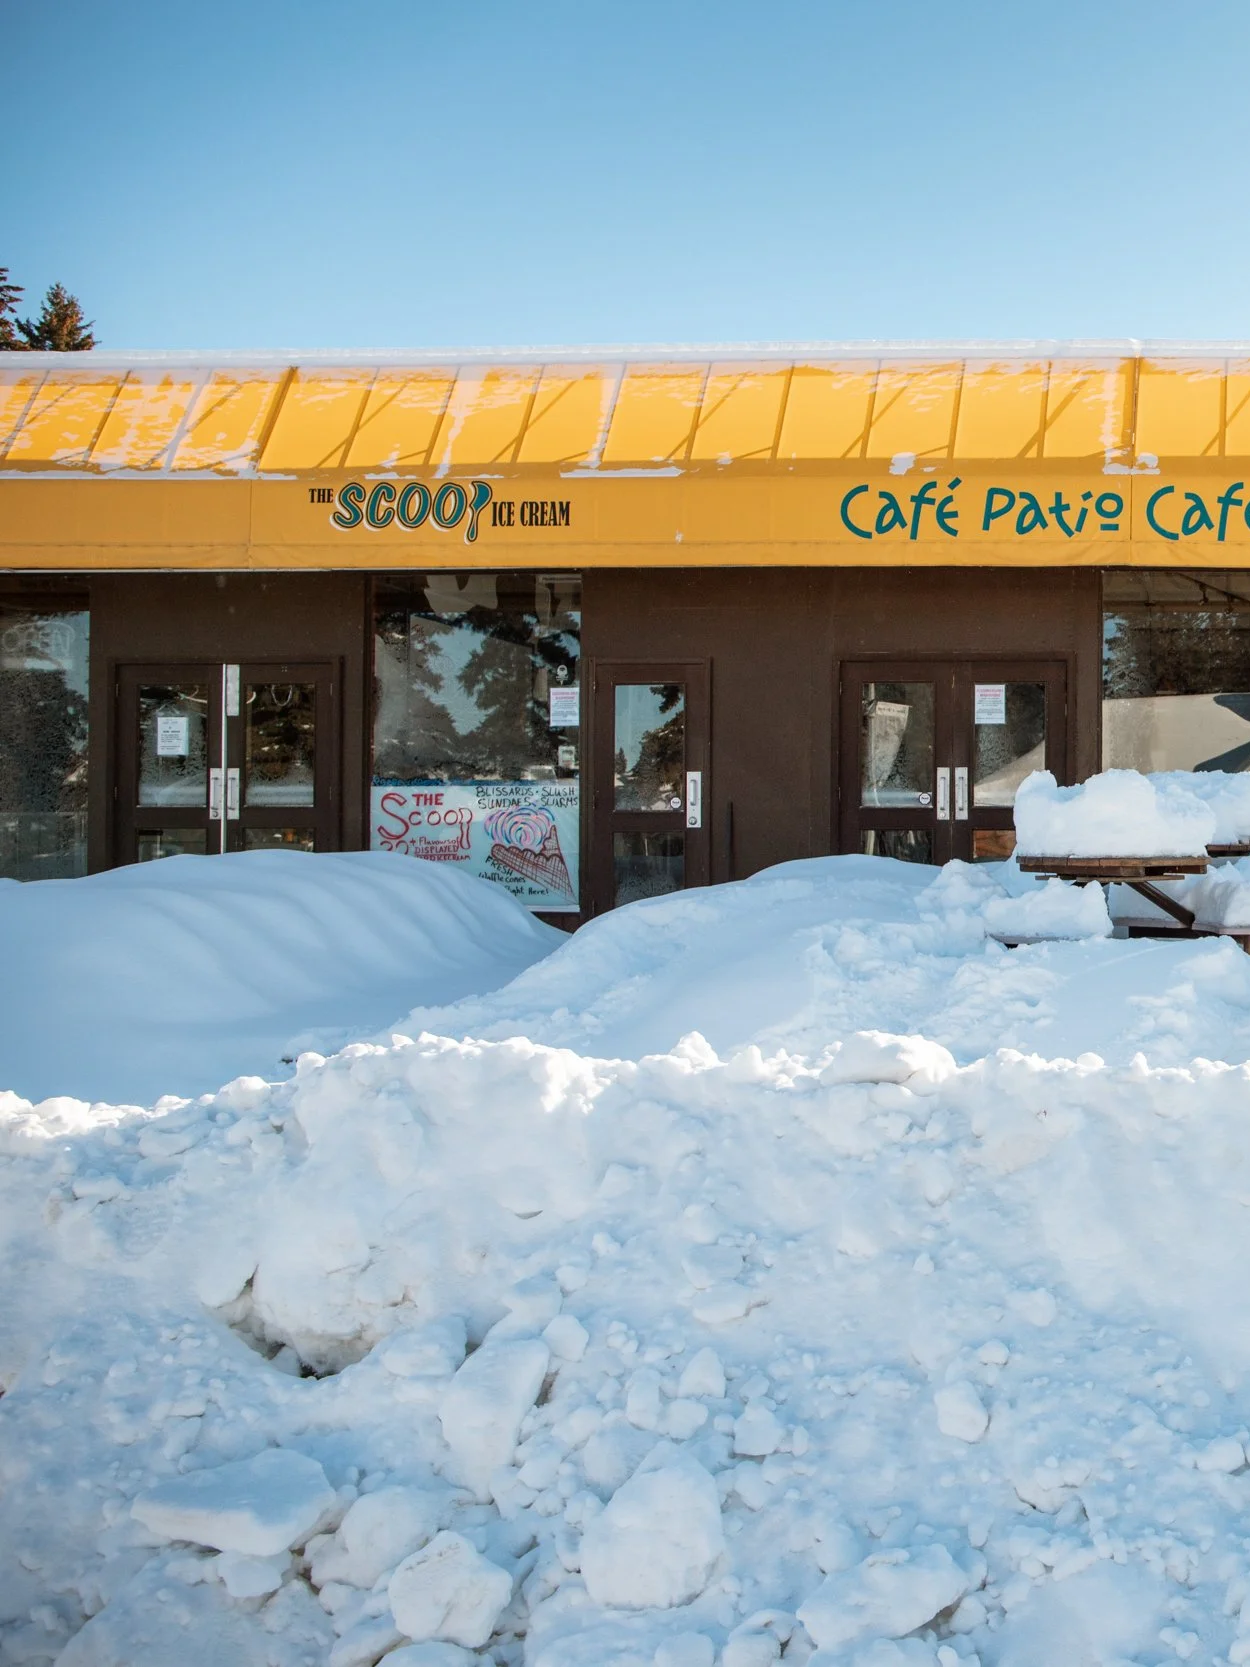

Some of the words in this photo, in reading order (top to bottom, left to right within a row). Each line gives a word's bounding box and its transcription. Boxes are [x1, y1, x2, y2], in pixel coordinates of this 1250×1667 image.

[309, 488, 333, 503] THE
[331, 480, 493, 544] SCOOP
[491, 501, 515, 527] ICE
[519, 501, 571, 527] CREAM
[840, 477, 962, 540] Café
[982, 487, 1124, 538] Patio
[412, 793, 444, 806] THE
[541, 786, 575, 797] SLUSH
[415, 845, 458, 854] DISPLAYED
[485, 856, 513, 876] FRESH
